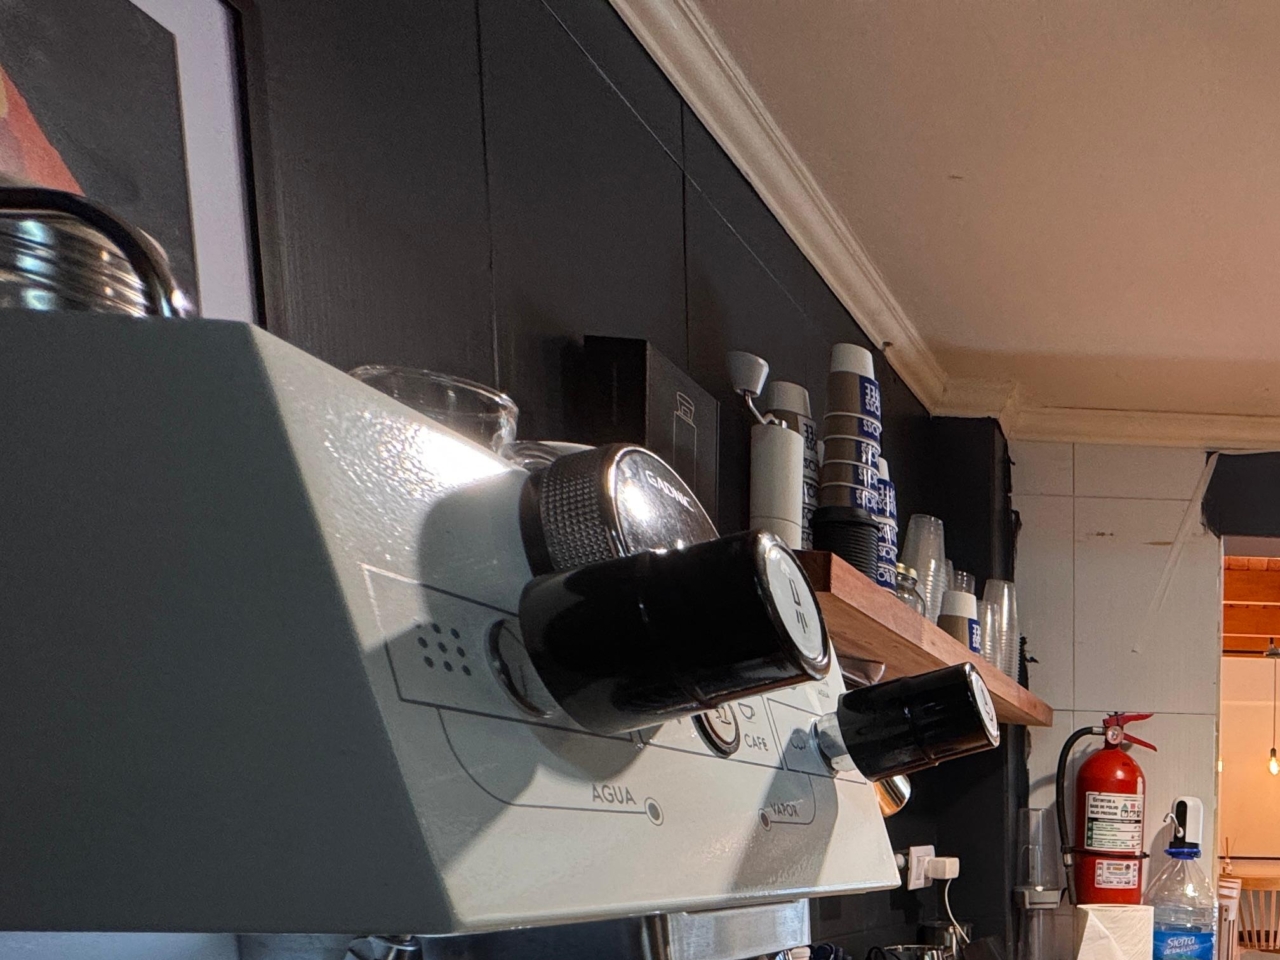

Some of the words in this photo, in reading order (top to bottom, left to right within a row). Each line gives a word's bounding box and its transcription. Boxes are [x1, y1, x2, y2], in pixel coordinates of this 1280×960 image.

[645, 470, 695, 512] GADNIC
[592, 783, 637, 805] AGUA
[769, 802, 799, 818] VAPOR
[1167, 936, 1195, 948] Sierra
